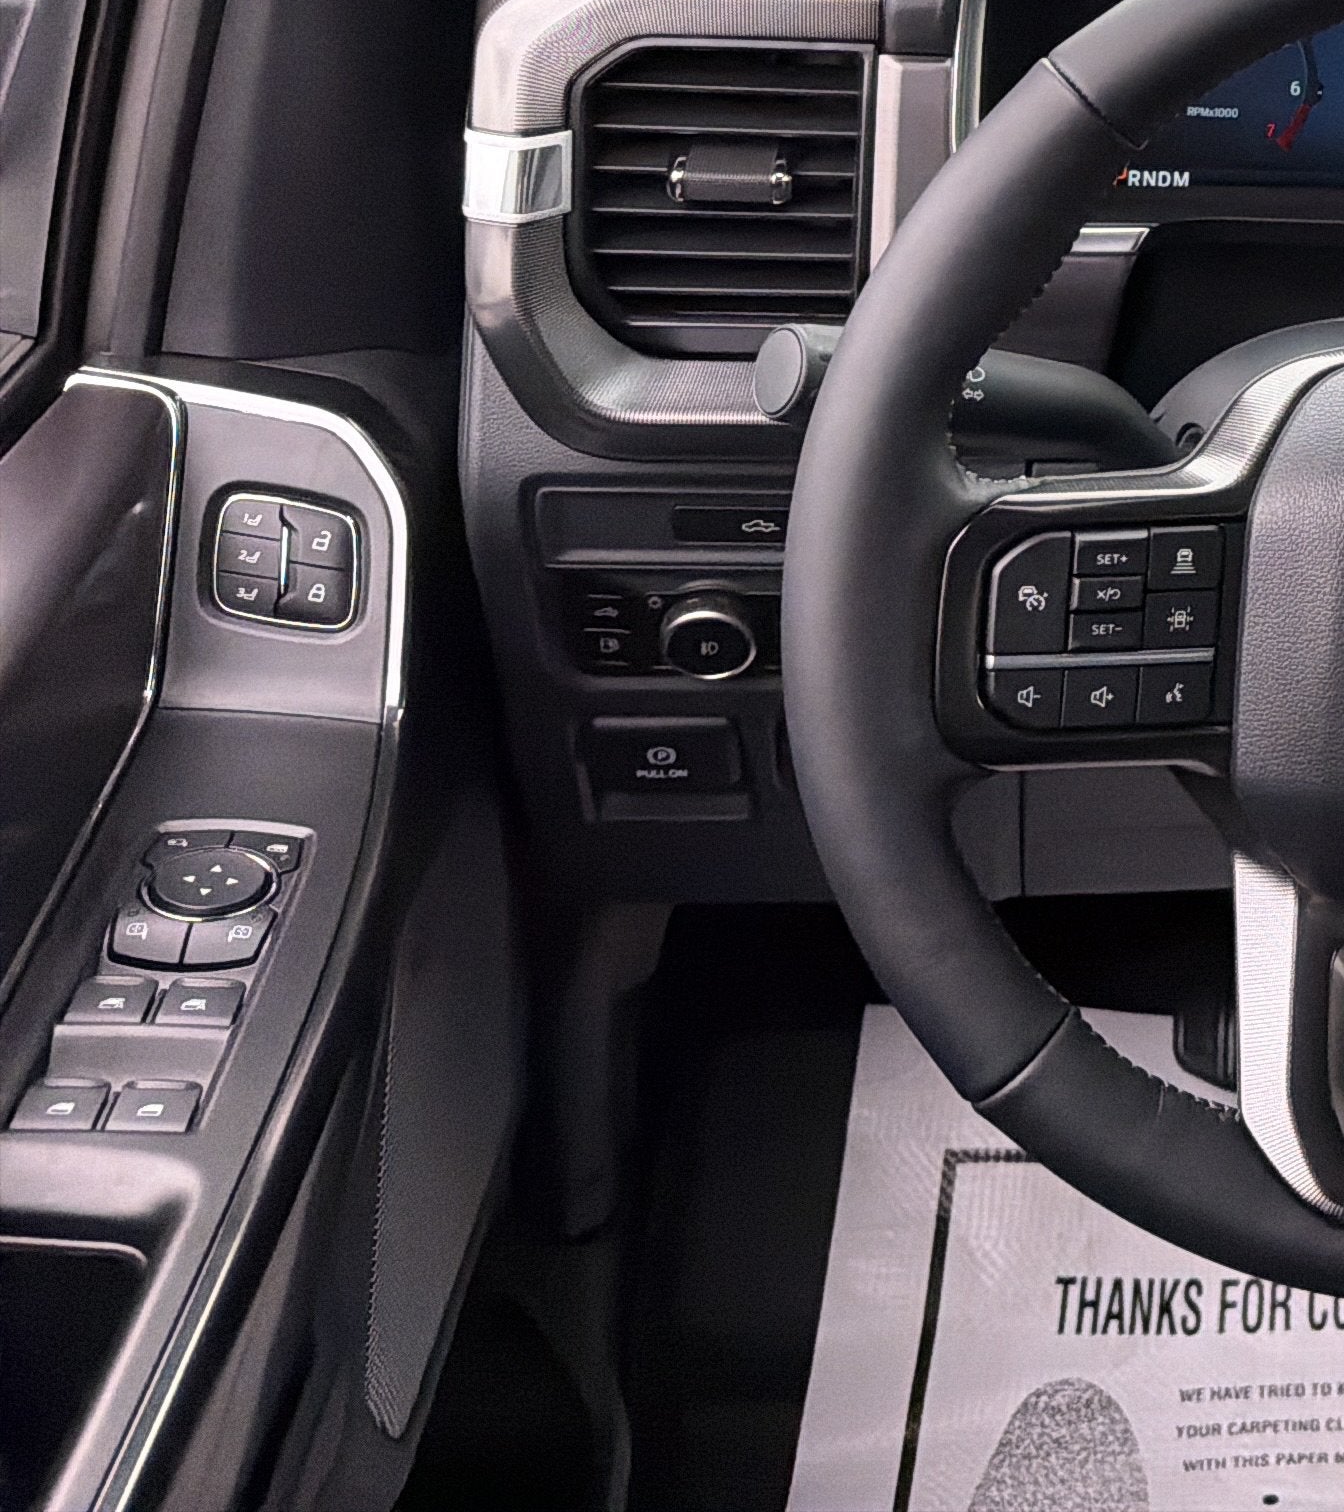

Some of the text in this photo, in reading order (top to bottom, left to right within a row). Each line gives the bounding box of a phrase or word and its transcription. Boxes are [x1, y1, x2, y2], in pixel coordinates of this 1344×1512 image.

[1290, 81, 1301, 96] 6
[1266, 123, 1276, 138] 7
[1112, 168, 1190, 187] RNDM
[636, 769, 688, 778] PULL ON
[1055, 1276, 1203, 1336] THANKS
[1218, 1277, 1292, 1334] FOR
[1179, 1388, 1204, 1403] WE
[1210, 1385, 1252, 1401] HAVE
[1258, 1383, 1306, 1399] TRIED
[1311, 1382, 1332, 1397] TO
[1176, 1422, 1222, 1439] YOUR
[1227, 1418, 1320, 1436] CARPETING
[1182, 1457, 1227, 1472] WITH
[1233, 1453, 1269, 1468] THIS
[1275, 1451, 1329, 1466] PAPER
